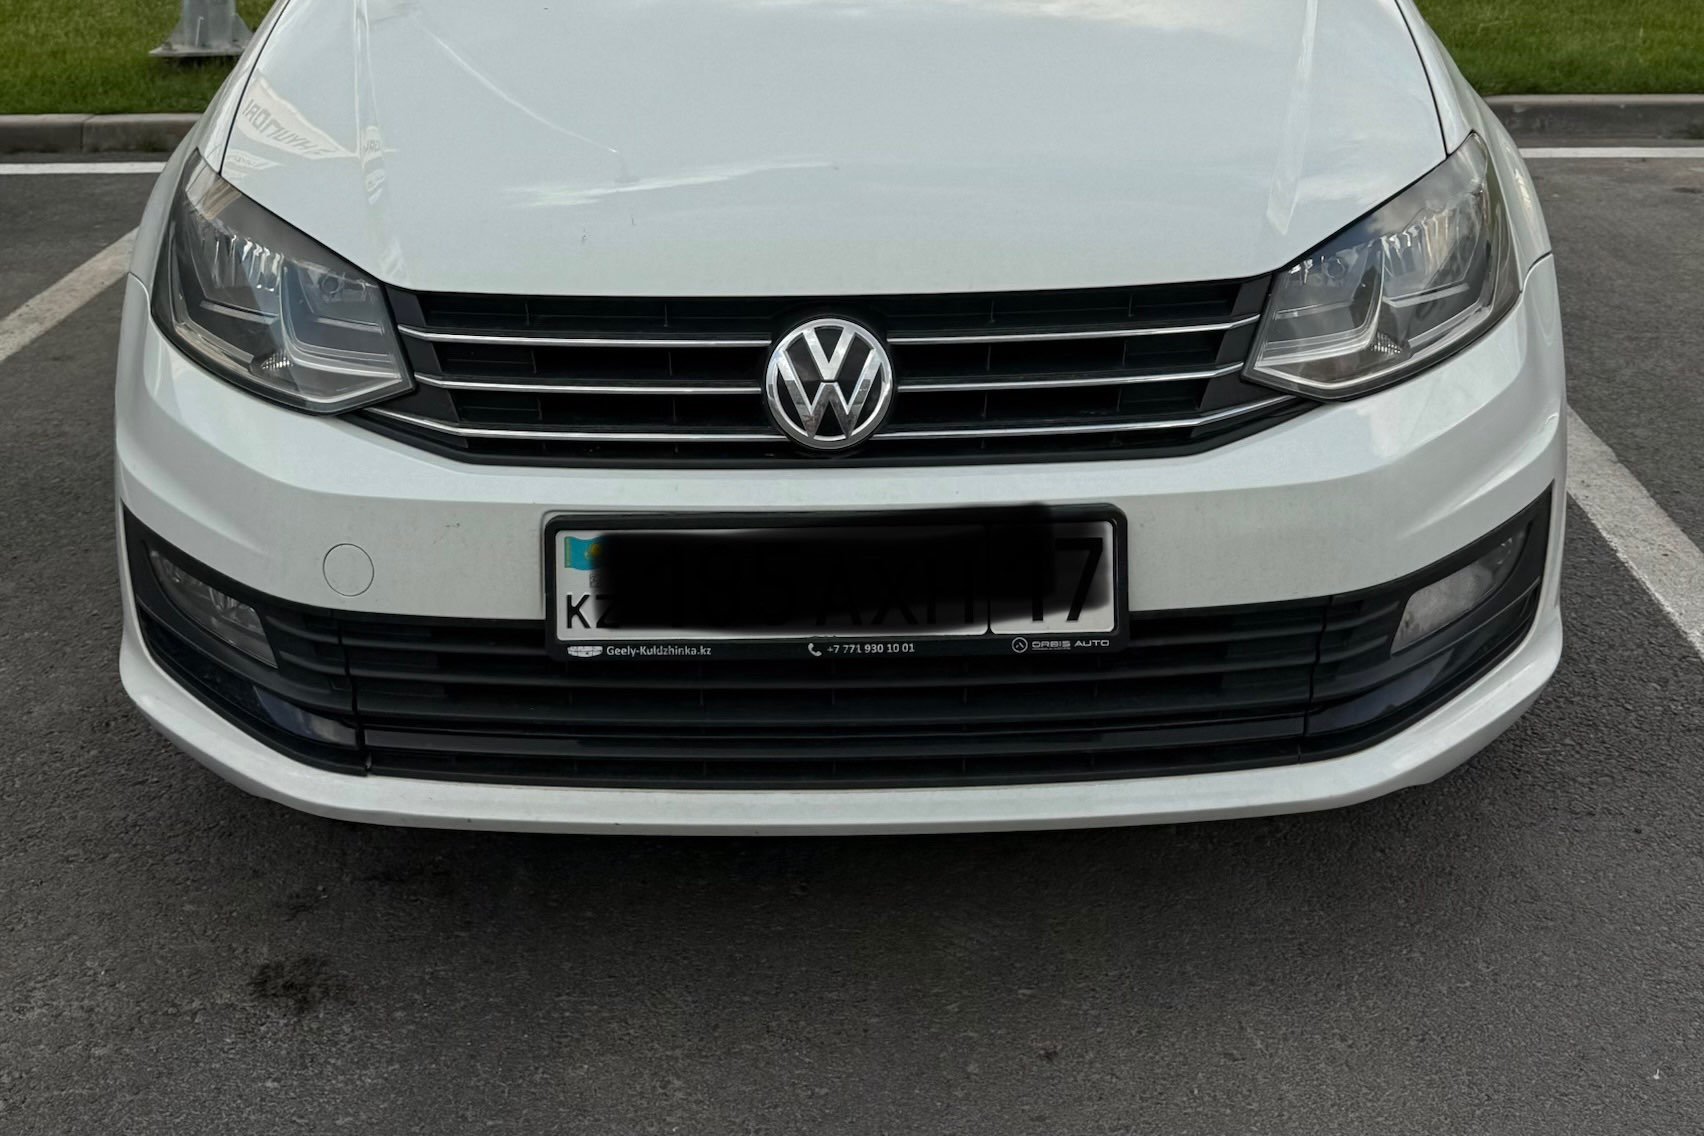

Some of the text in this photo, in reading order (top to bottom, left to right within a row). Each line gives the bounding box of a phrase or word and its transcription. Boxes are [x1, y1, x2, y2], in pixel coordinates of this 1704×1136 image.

[826, 642, 915, 654] +7 771 930 10 01
[1031, 639, 1110, 649] ORBIS AUTO
[606, 645, 712, 658] Geely-Kuldzhinka.kz
